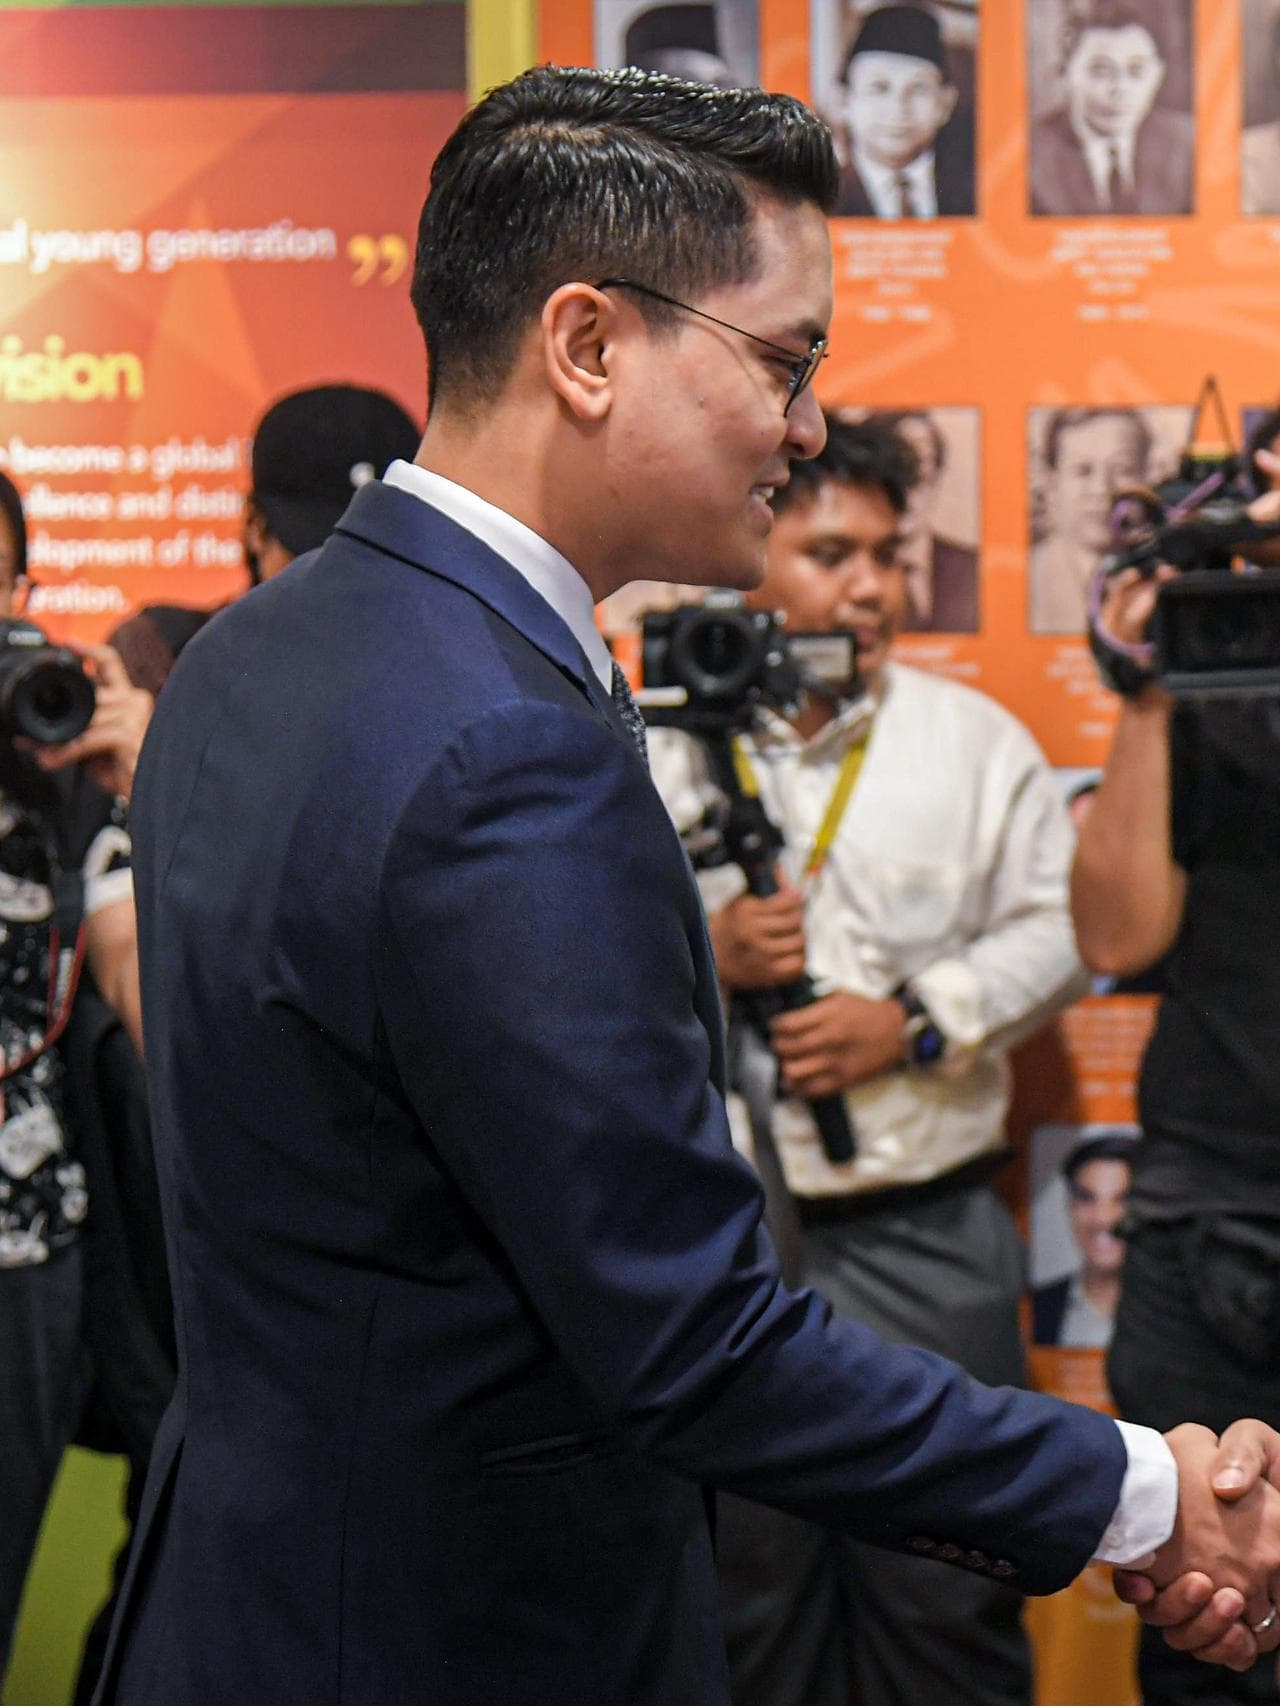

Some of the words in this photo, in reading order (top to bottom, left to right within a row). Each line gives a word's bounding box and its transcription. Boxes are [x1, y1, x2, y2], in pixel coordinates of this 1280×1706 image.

[30, 229, 142, 272] young
[147, 219, 337, 271] generation
[0, 334, 143, 402] ision
[10, 435, 124, 473] become
[152, 434, 239, 481] global
[158, 528, 190, 566] of
[193, 530, 243, 566] the
